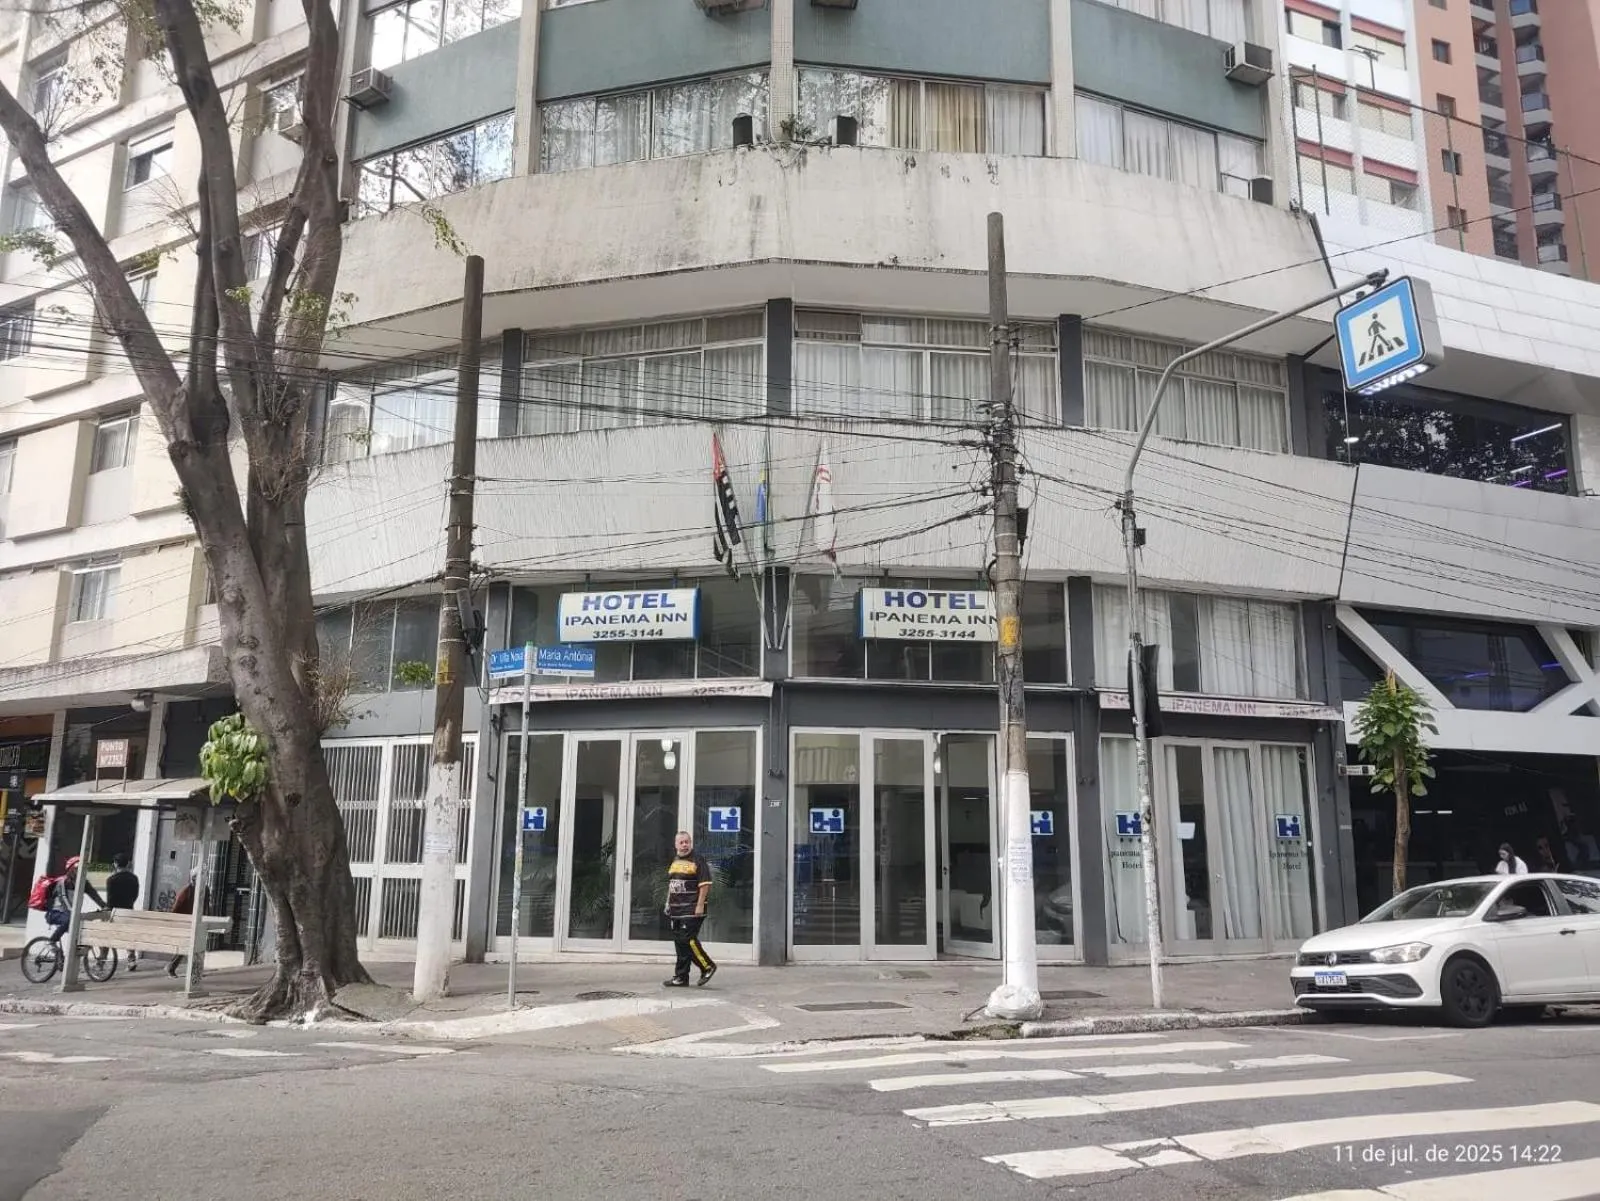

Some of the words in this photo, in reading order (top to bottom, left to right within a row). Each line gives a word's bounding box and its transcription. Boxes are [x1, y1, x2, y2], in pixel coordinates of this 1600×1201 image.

[582, 593, 676, 611] HOTEL
[884, 591, 986, 610] HOTEL
[565, 613, 649, 626] IPANEMA
[656, 612, 688, 623] INN
[870, 611, 961, 625] IPANEMA
[968, 615, 998, 625] INN
[592, 628, 664, 639] 3255-3144
[899, 628, 976, 640] 3255-3144
[539, 649, 561, 661] Maria
[563, 649, 593, 662] Antônia
[566, 686, 632, 699] IPANEMA
[637, 685, 663, 697] INN
[1172, 699, 1231, 714] IPANEMA
[1235, 703, 1257, 715] INN
